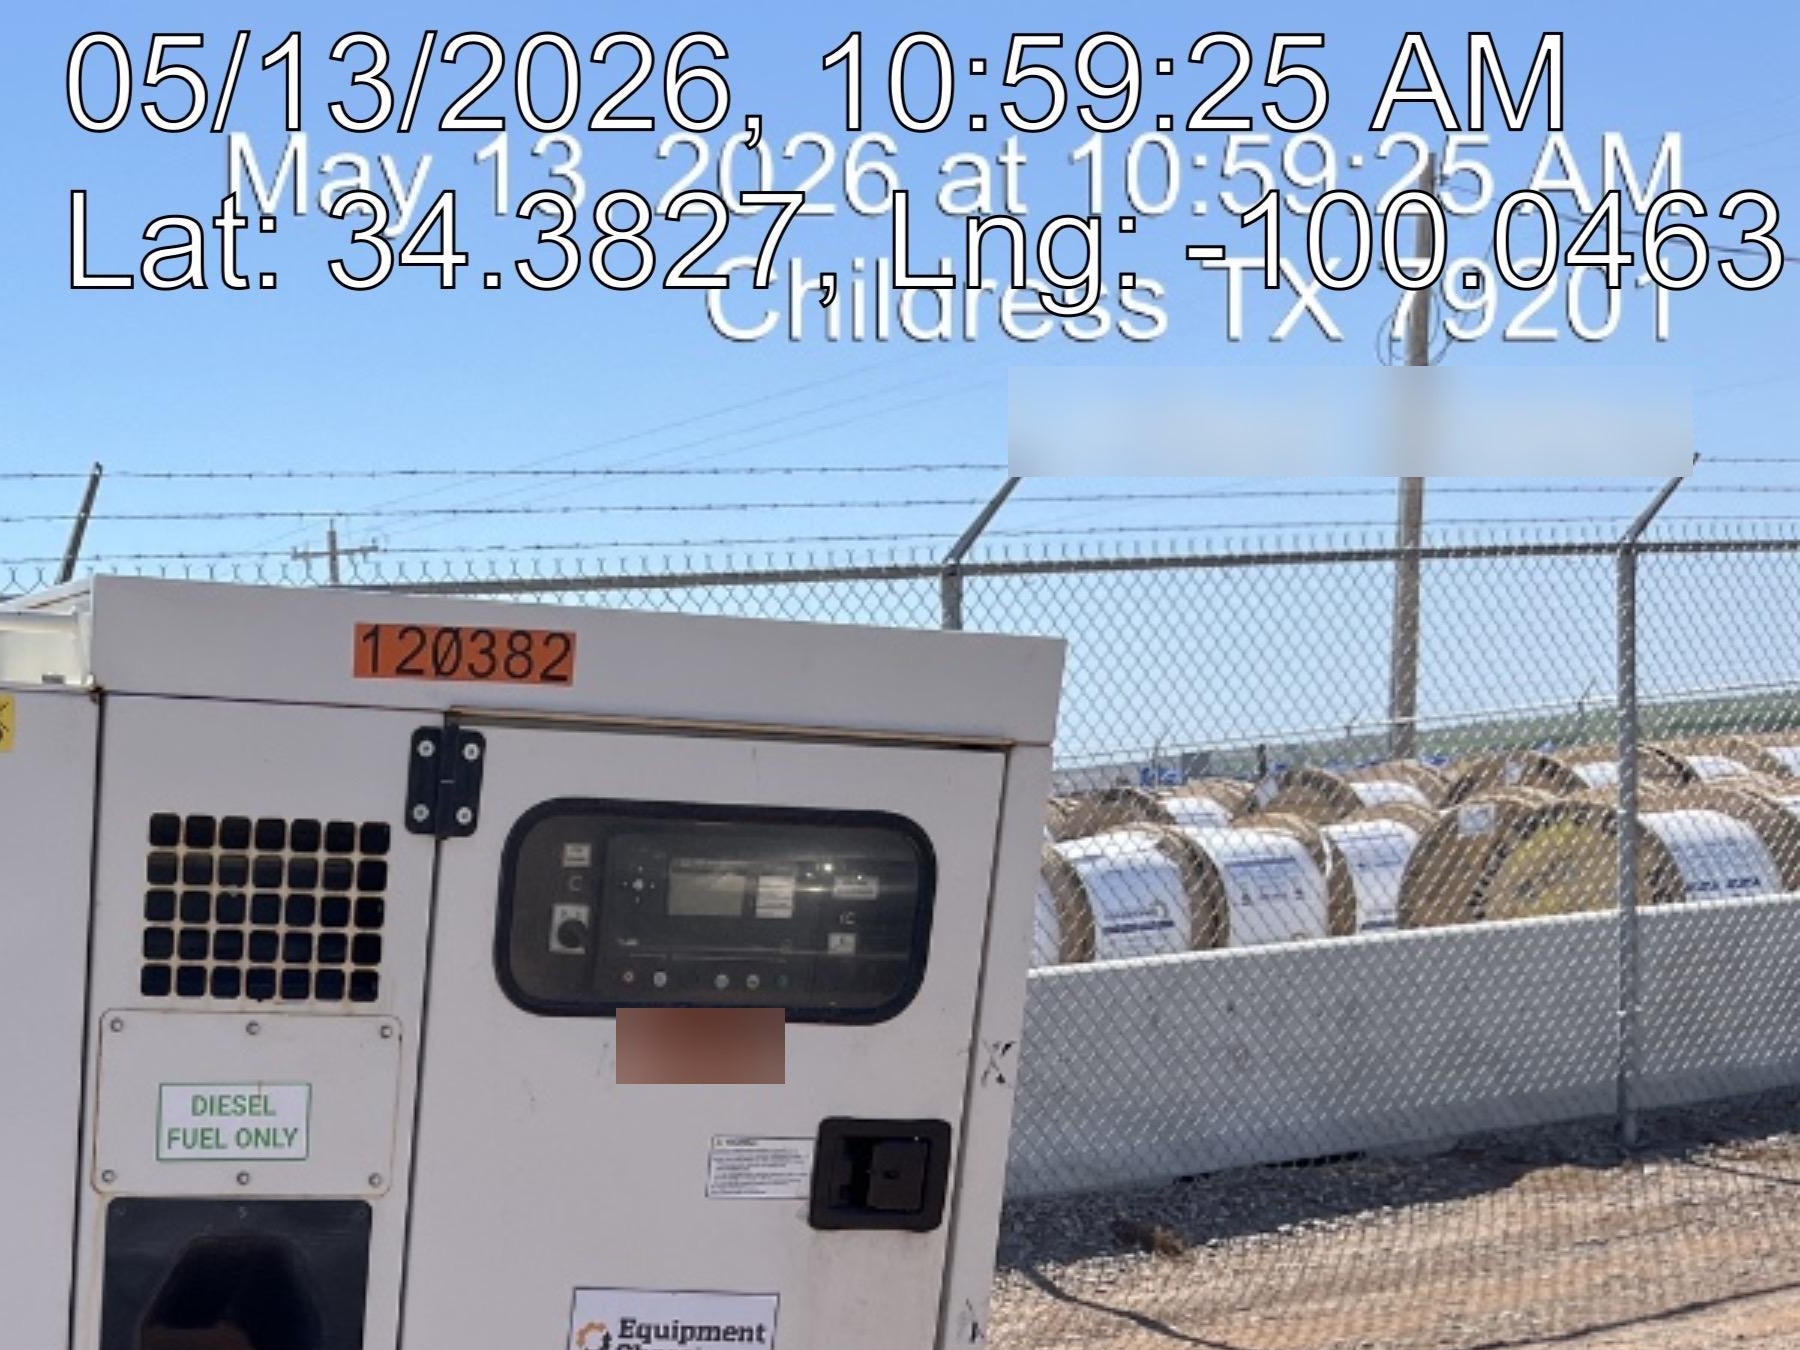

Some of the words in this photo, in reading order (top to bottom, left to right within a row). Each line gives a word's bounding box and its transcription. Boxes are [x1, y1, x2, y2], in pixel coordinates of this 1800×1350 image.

[361, 623, 572, 682] 120382
[190, 1094, 276, 1117] DIESEL
[166, 1127, 228, 1150] FUEL
[234, 1127, 298, 1149] ONLY
[617, 1317, 766, 1345] Equipment
